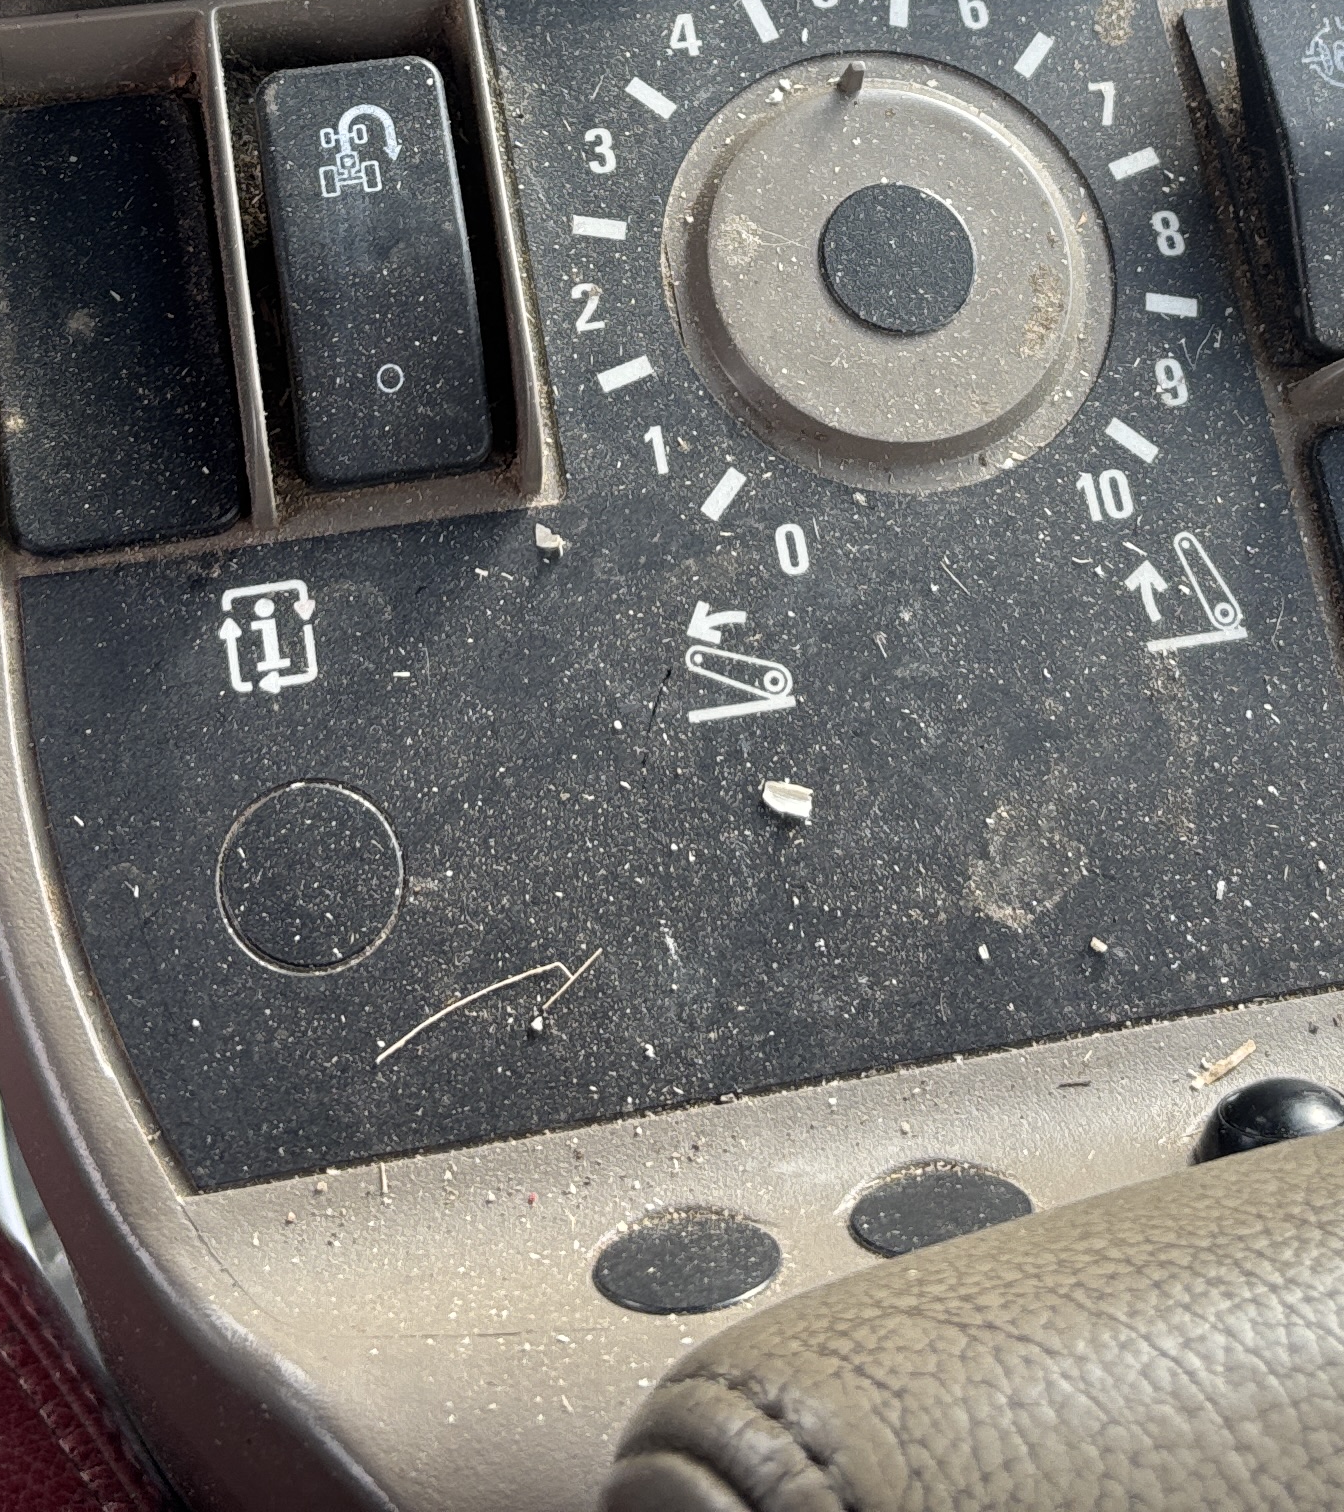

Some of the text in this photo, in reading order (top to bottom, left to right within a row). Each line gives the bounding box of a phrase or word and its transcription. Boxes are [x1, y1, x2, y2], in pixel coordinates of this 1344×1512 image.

[669, 13, 703, 57] 4
[1087, 80, 1117, 127] 7
[584, 127, 617, 174] 3
[1150, 210, 1186, 257] 8
[570, 282, 608, 335] 2
[1154, 358, 1189, 408] 9
[644, 425, 670, 475] 1
[1075, 468, 1134, 522] 10
[774, 522, 810, 576] 0
